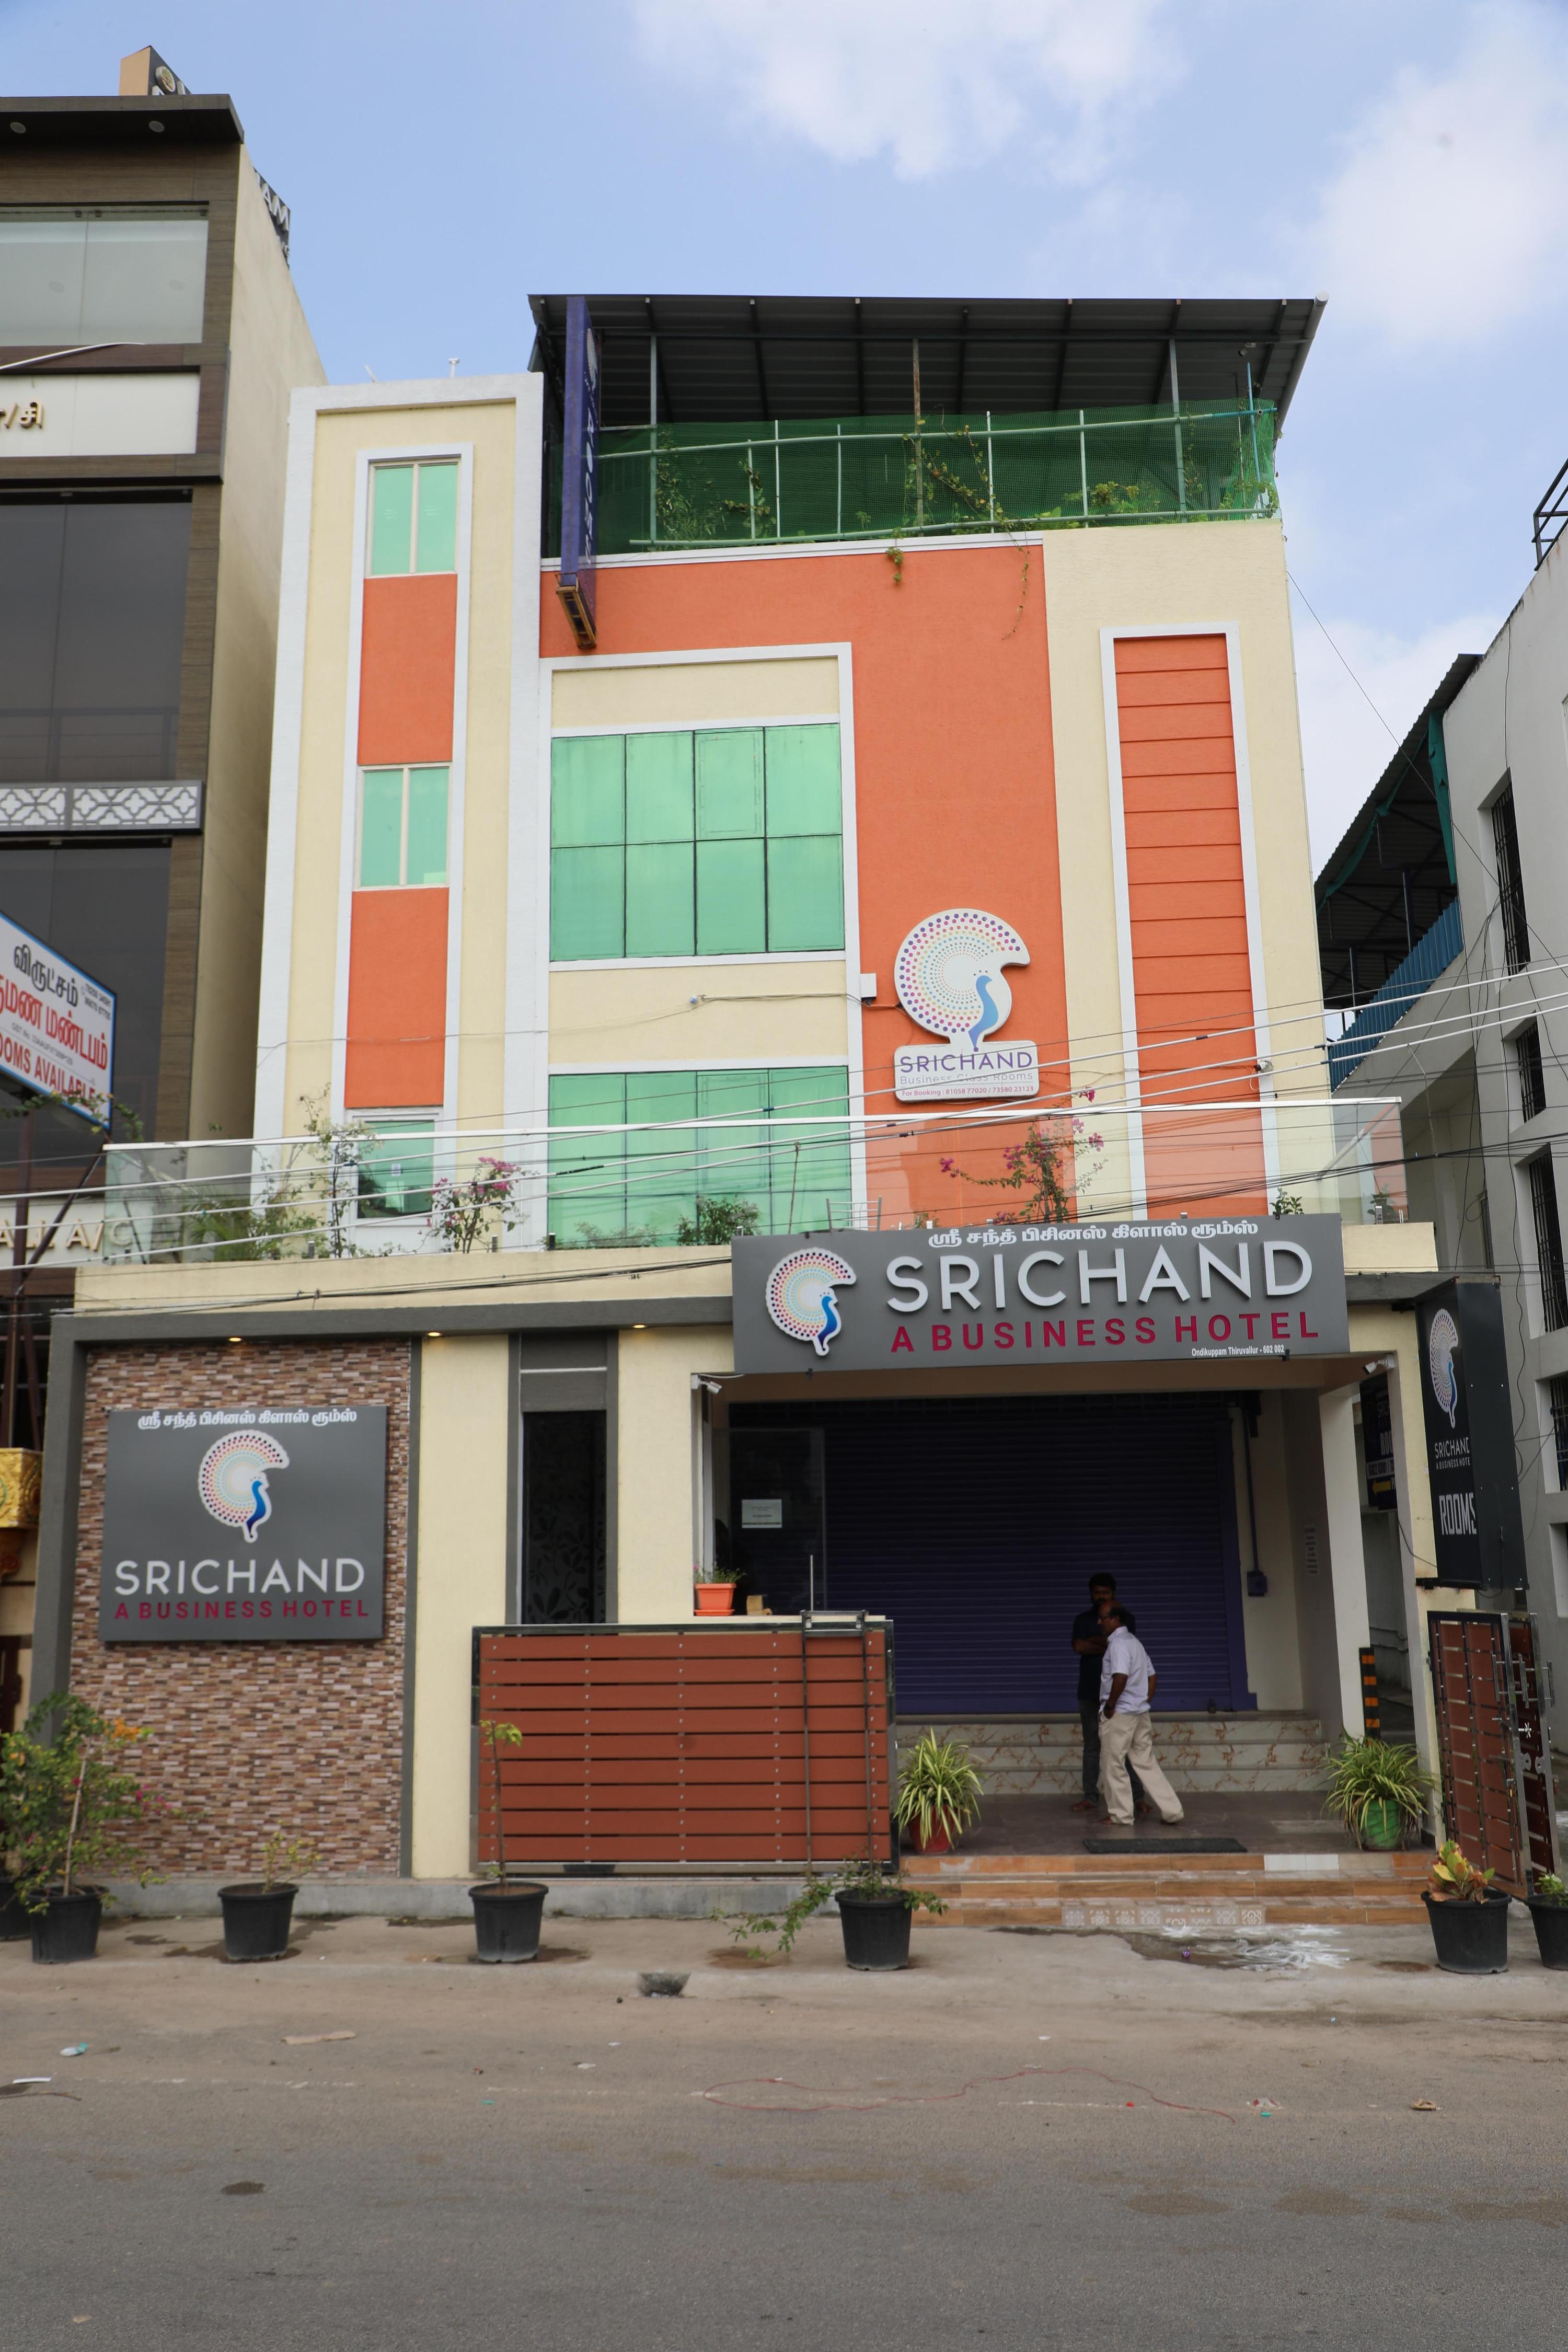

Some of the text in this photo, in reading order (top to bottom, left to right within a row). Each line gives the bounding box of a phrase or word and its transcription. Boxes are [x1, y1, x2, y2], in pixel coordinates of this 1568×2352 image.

[256, 172, 289, 230] AM
[900, 1052, 1032, 1073] SRICHAND
[900, 1074, 952, 1085] Business
[966, 1229, 1017, 1247] சந்த்
[1022, 1225, 1107, 1242] பிசினஸ்
[1112, 1222, 1187, 1239] கிளாஸ்
[1191, 1219, 1259, 1239] ரூம்ஸ்
[886, 1241, 1313, 1313] SRICHAND
[891, 1312, 1319, 1353] A BUSINESS HOTEL
[1191, 1347, 1227, 1357] Ondikuppam
[1228, 1346, 1259, 1355] Thiruvallur
[1263, 1345, 1273, 1353] 602
[1274, 1344, 1285, 1353] 002
[163, 1412, 197, 1429] சந்த்
[199, 1410, 256, 1425] பிசினஸ்
[258, 1409, 309, 1424] கிளாஸ்
[312, 1408, 358, 1426] ரூம்ஸ்
[1439, 1492, 1477, 1536] ROOMS
[114, 1558, 365, 1595] SRICHAND
[114, 1599, 368, 1620] A BUSINESS HOTEL
